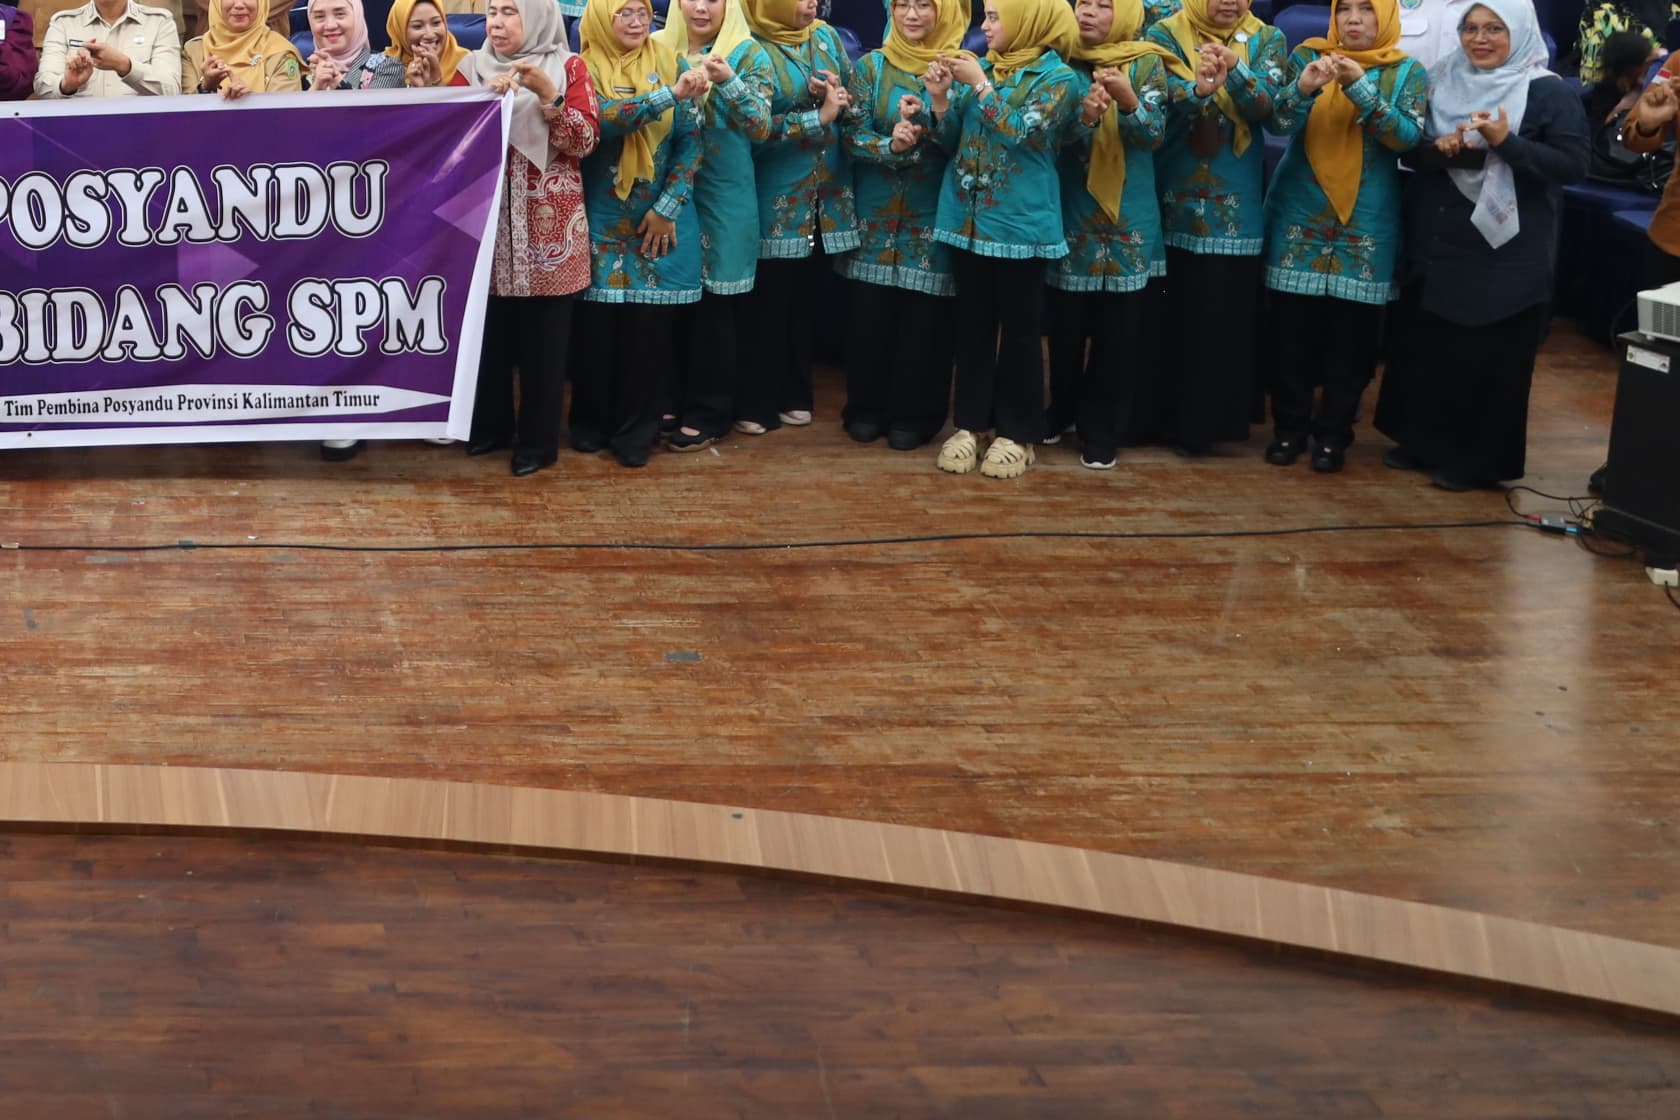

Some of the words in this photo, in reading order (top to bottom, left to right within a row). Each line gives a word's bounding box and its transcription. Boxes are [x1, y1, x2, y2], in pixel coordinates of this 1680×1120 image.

[286, 276, 448, 357] SPM
[4, 399, 33, 416] Tim
[37, 397, 100, 416] Pembina
[103, 394, 174, 416] Posyandu
[177, 392, 239, 411] Provinsi
[242, 391, 329, 410] Kalimantan
[333, 390, 380, 408] Timur
